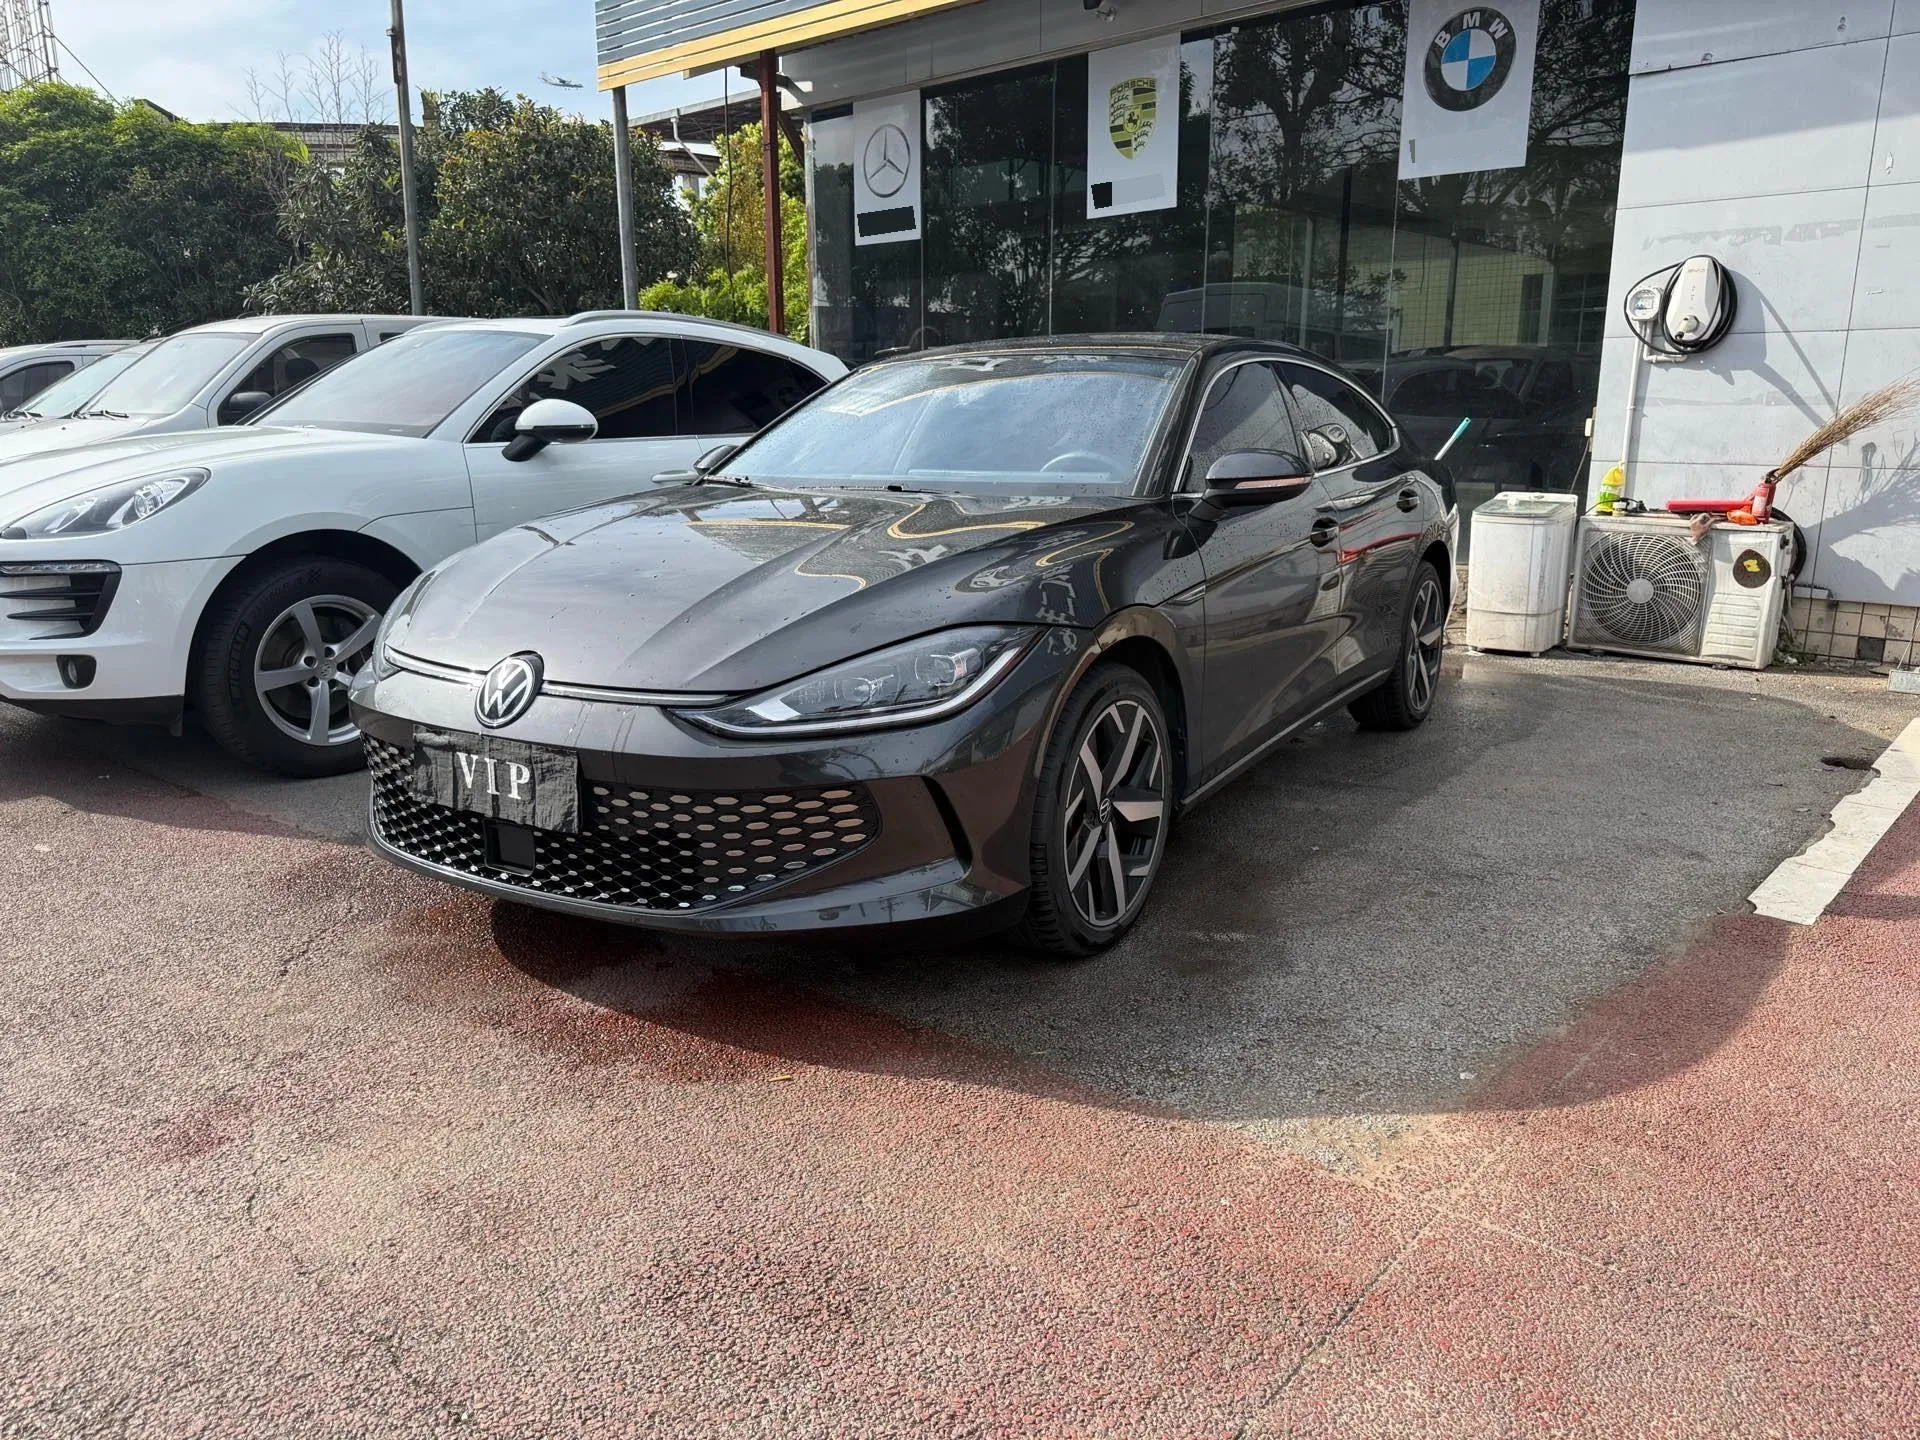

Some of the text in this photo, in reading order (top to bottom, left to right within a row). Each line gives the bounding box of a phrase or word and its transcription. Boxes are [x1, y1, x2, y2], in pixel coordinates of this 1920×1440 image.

[1435, 12, 1508, 49] BMW
[1110, 80, 1156, 97] PORSCHE
[457, 752, 531, 800] VIP
